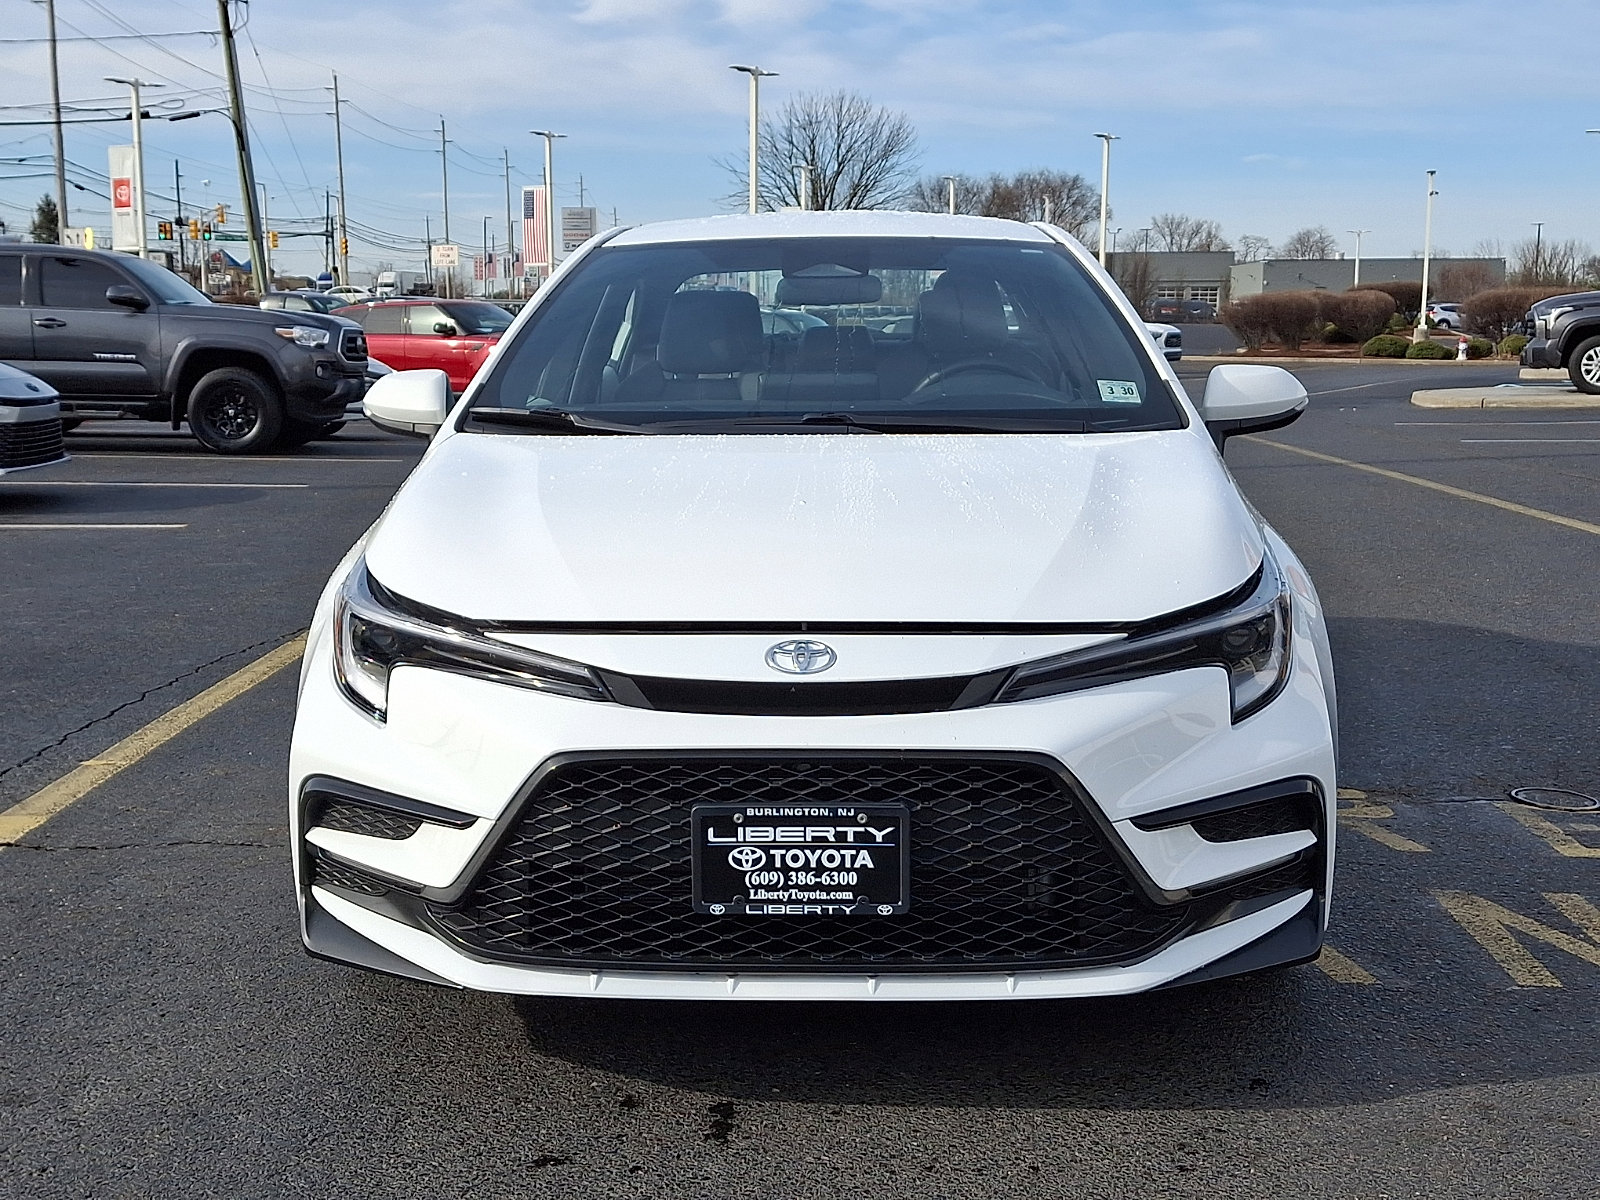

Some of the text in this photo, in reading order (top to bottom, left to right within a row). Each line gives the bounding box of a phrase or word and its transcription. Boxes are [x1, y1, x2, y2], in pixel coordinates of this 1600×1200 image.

[1106, 386, 1135, 395] 3 30
[746, 807, 855, 817] BURLINGTON, NJ
[707, 826, 896, 843] LIBERTY
[769, 848, 875, 869] TOYOTA
[744, 871, 858, 888] (609) 386-6300
[749, 888, 854, 901] LibertyToyota.com
[745, 904, 857, 915] LIBERTY
